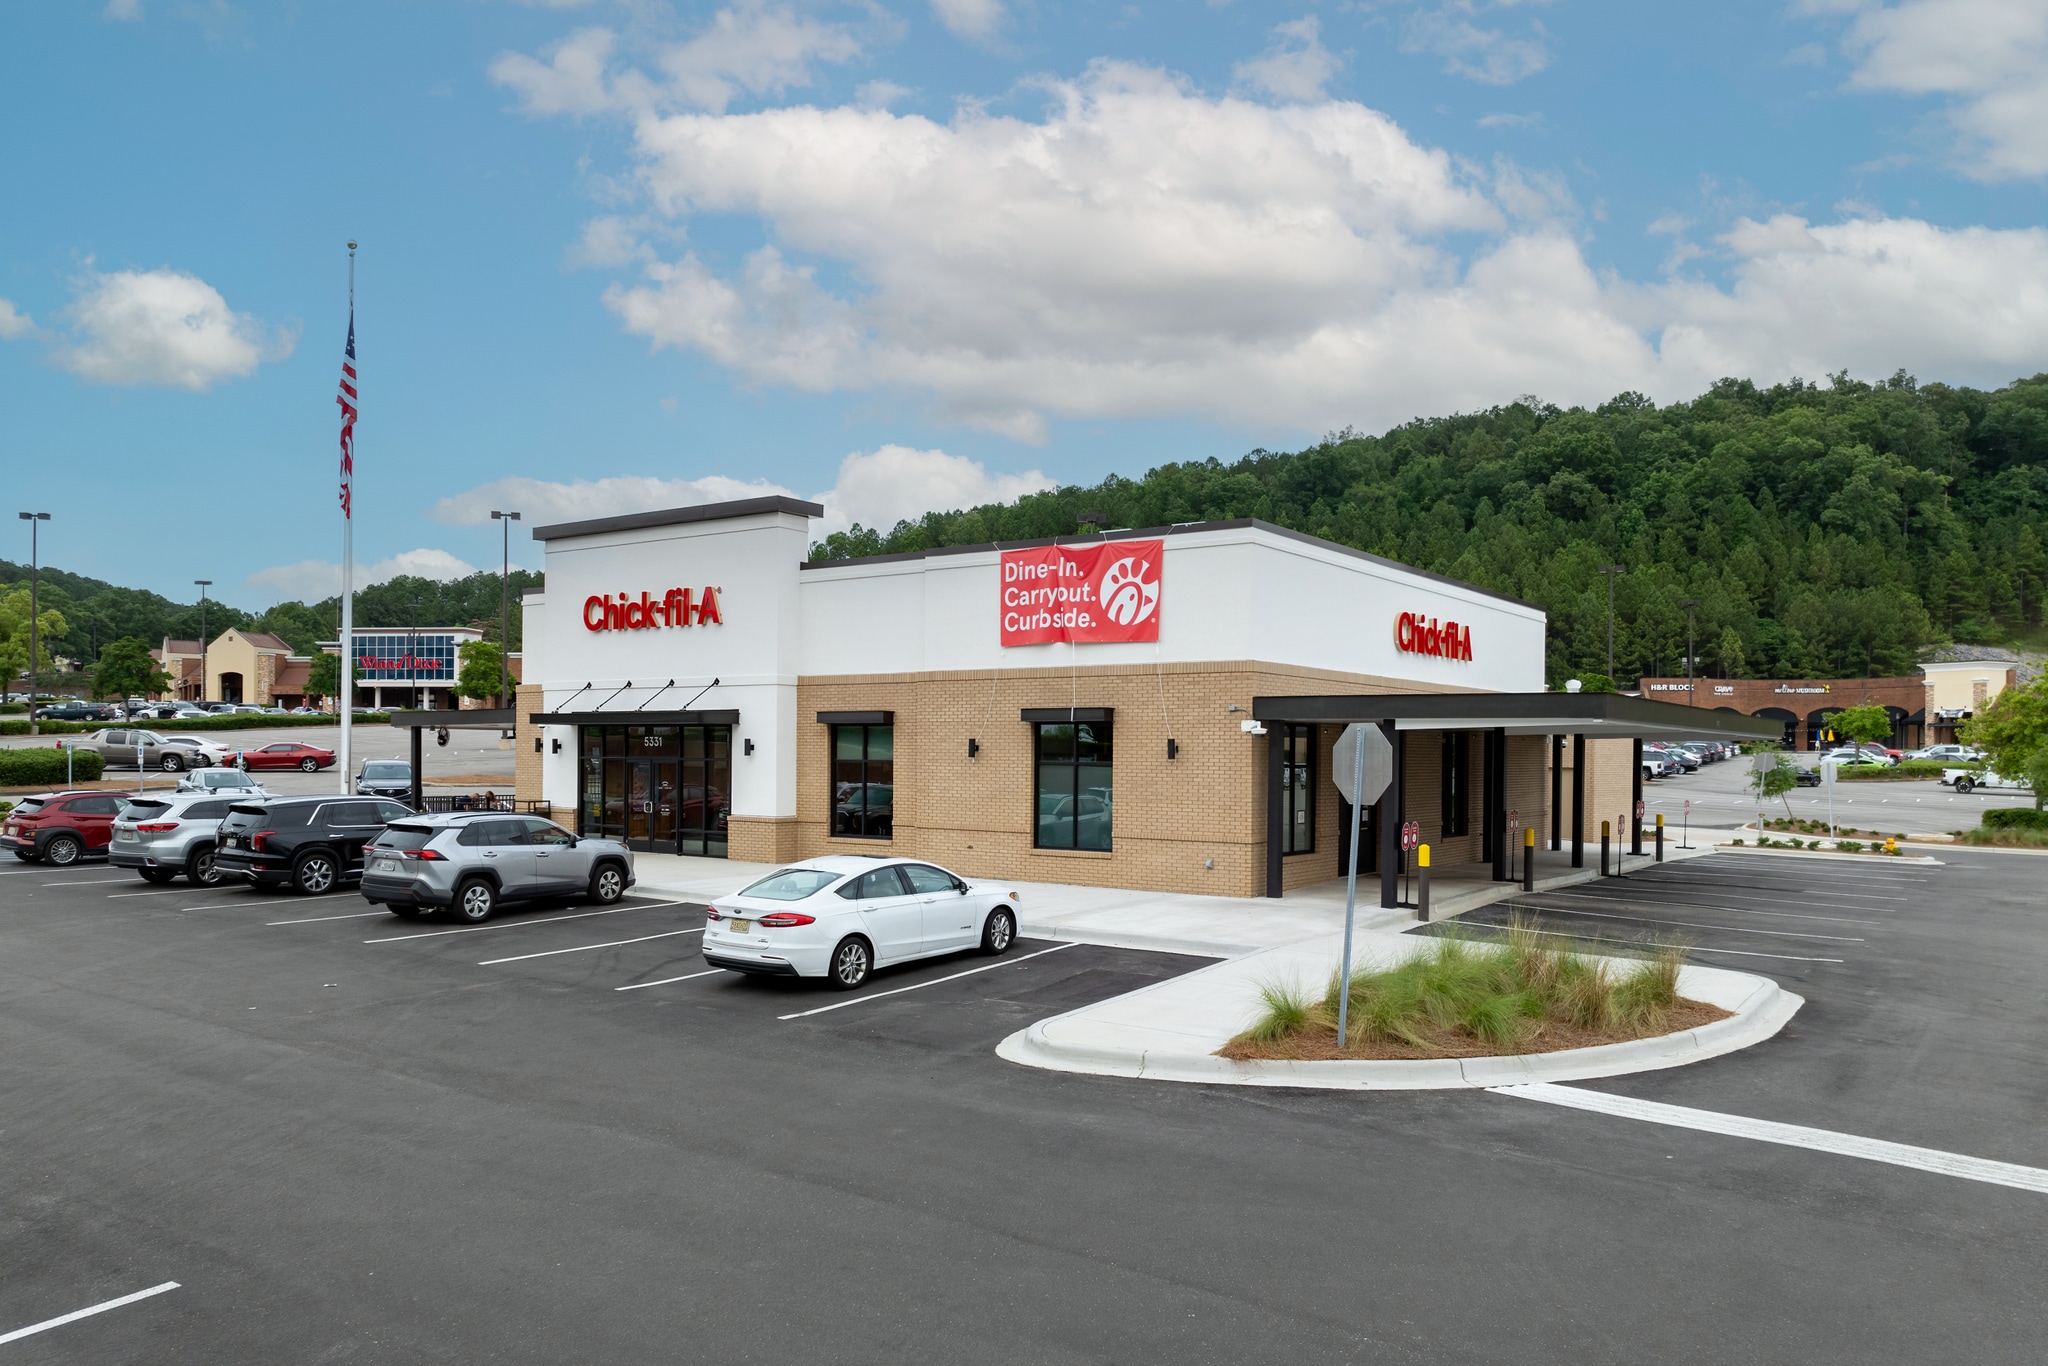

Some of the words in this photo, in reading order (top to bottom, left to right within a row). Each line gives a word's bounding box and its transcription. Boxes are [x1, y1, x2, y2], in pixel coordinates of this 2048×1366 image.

[1004, 557, 1084, 582] Dine-In.
[1004, 582, 1096, 607] Carryout.
[583, 586, 723, 632] Chick-fil-A
[1004, 607, 1096, 632] Curbside.
[1394, 611, 1473, 662] Chick-fil-A
[359, 655, 396, 669] Winn
[405, 655, 443, 669] Dixie
[644, 736, 663, 747] 5331
